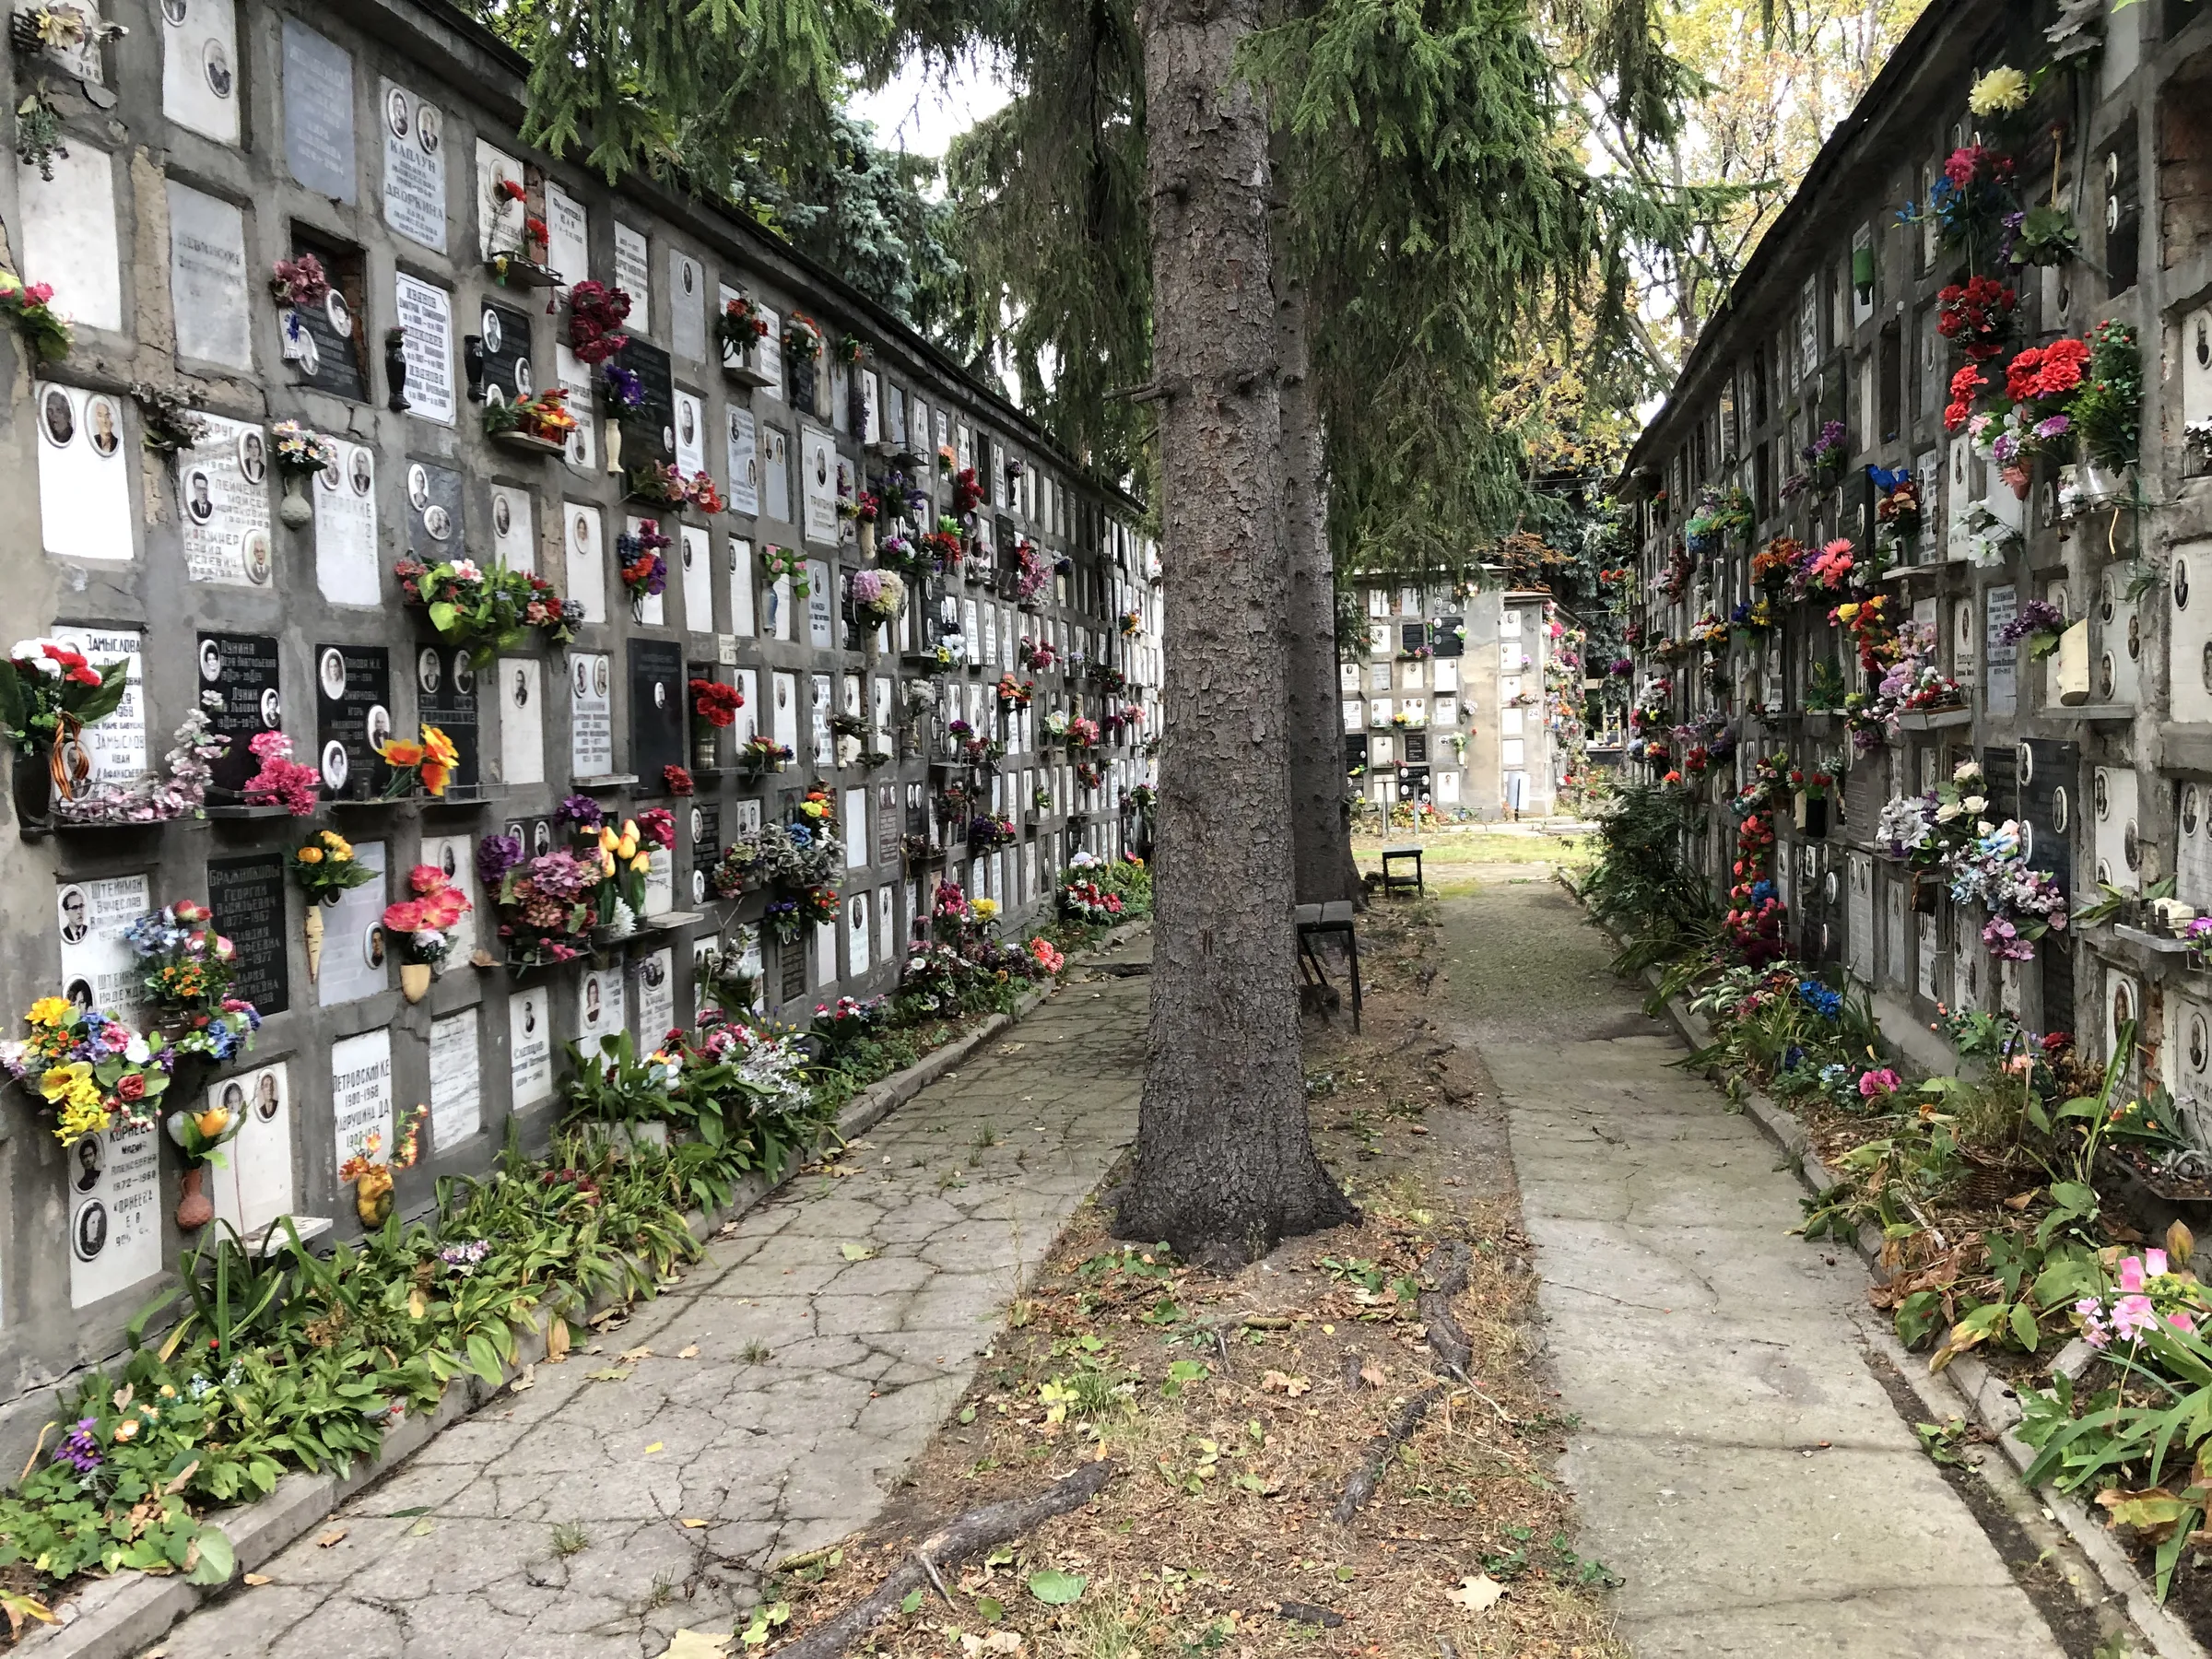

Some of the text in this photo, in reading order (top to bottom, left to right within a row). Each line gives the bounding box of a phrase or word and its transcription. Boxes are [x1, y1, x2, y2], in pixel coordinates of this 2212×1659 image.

[390, 139, 437, 174] КАПЛУН
[385, 183, 444, 221] ДВОРКИНА
[86, 634, 141, 653] ЗАМЫСЛОВА
